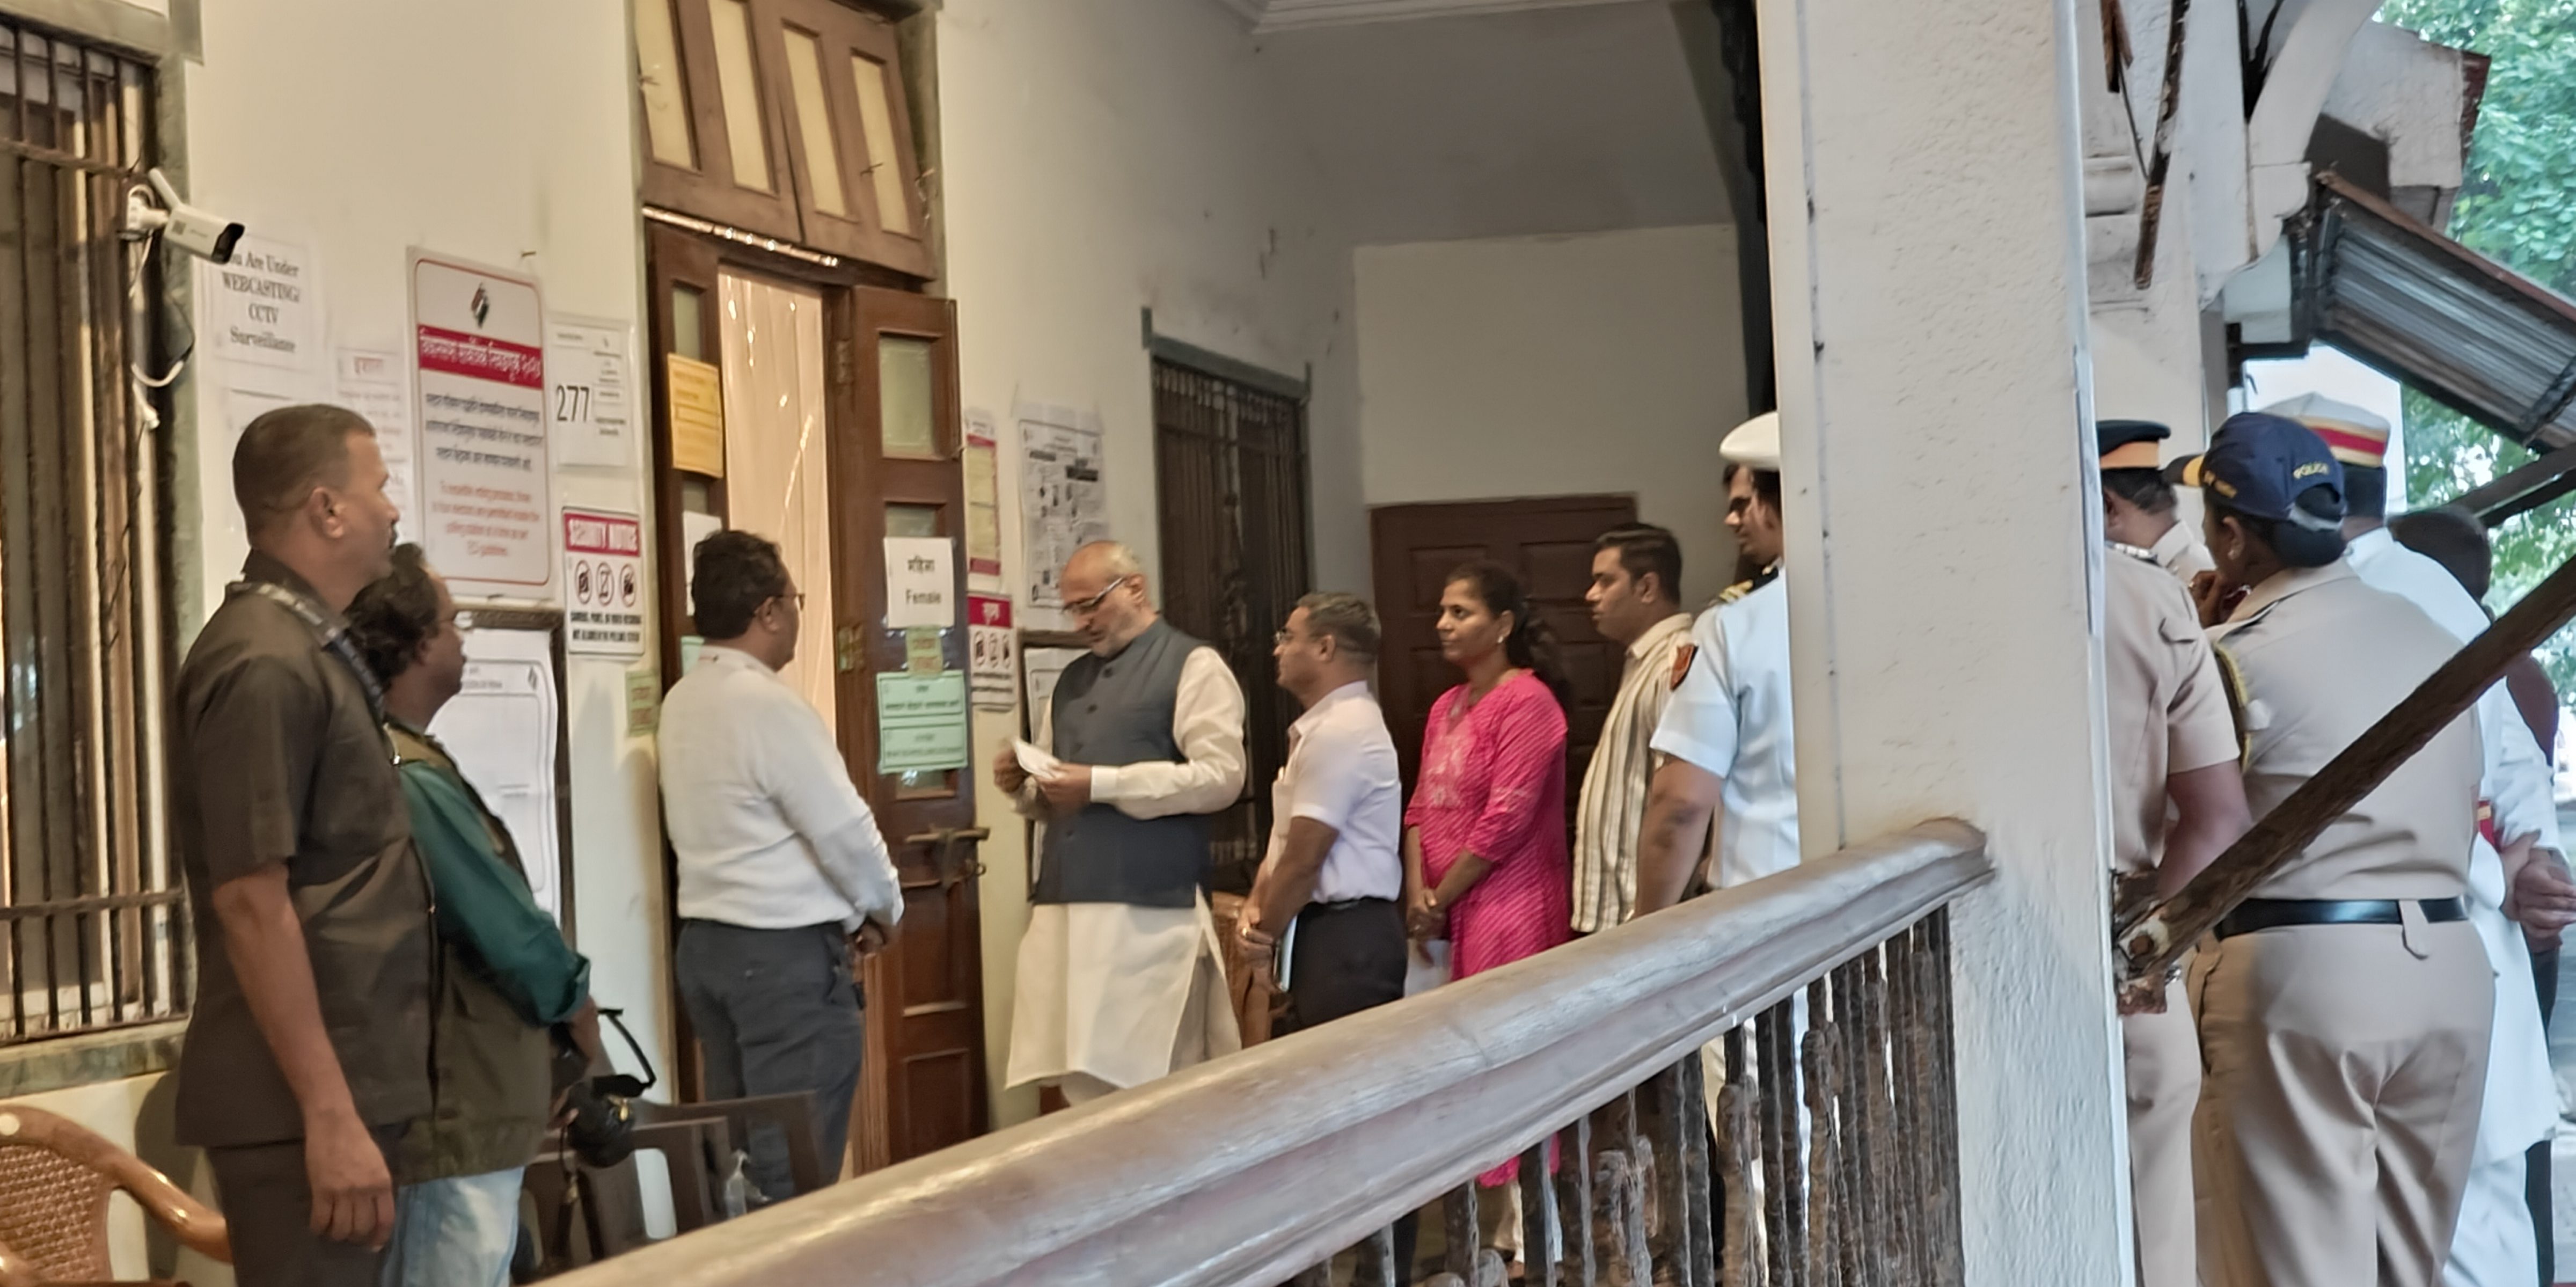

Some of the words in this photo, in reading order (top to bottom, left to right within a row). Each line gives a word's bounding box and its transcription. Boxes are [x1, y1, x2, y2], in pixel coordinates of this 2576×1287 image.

[246, 251, 264, 270] Are
[266, 254, 299, 276] Under
[248, 302, 279, 324] CCTV
[557, 384, 589, 422] 277
[2293, 462, 2329, 479] POLICE
[905, 589, 941, 604] Female
